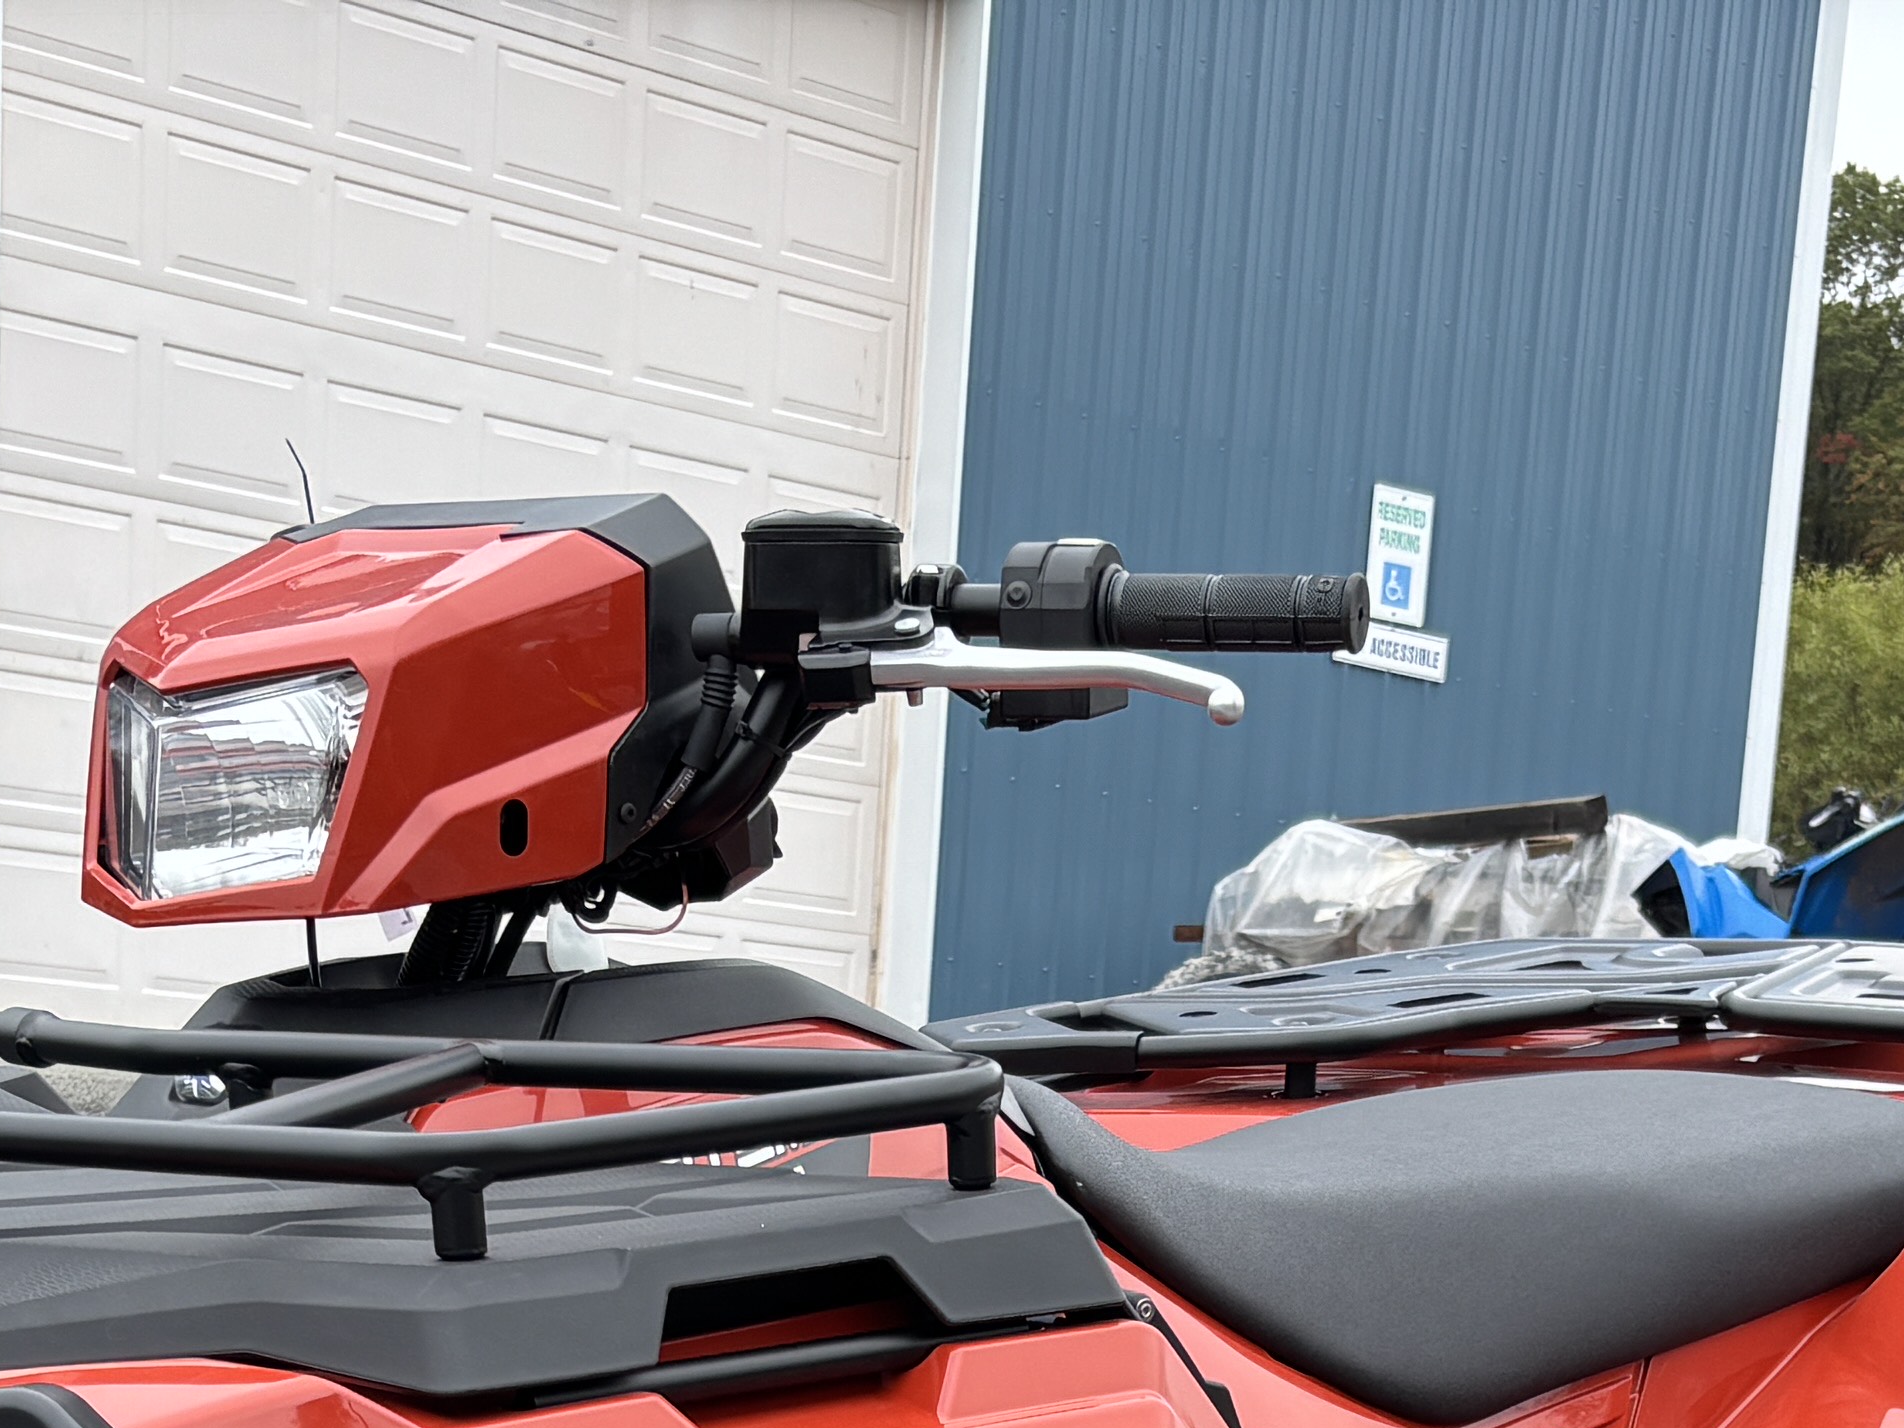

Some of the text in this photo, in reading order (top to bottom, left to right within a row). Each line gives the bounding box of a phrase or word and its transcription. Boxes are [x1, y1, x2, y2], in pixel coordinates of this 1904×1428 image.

[1378, 501, 1427, 530] RESERVED
[1378, 527, 1421, 554] PARKING
[1369, 637, 1441, 670] ACCESSIBLE
